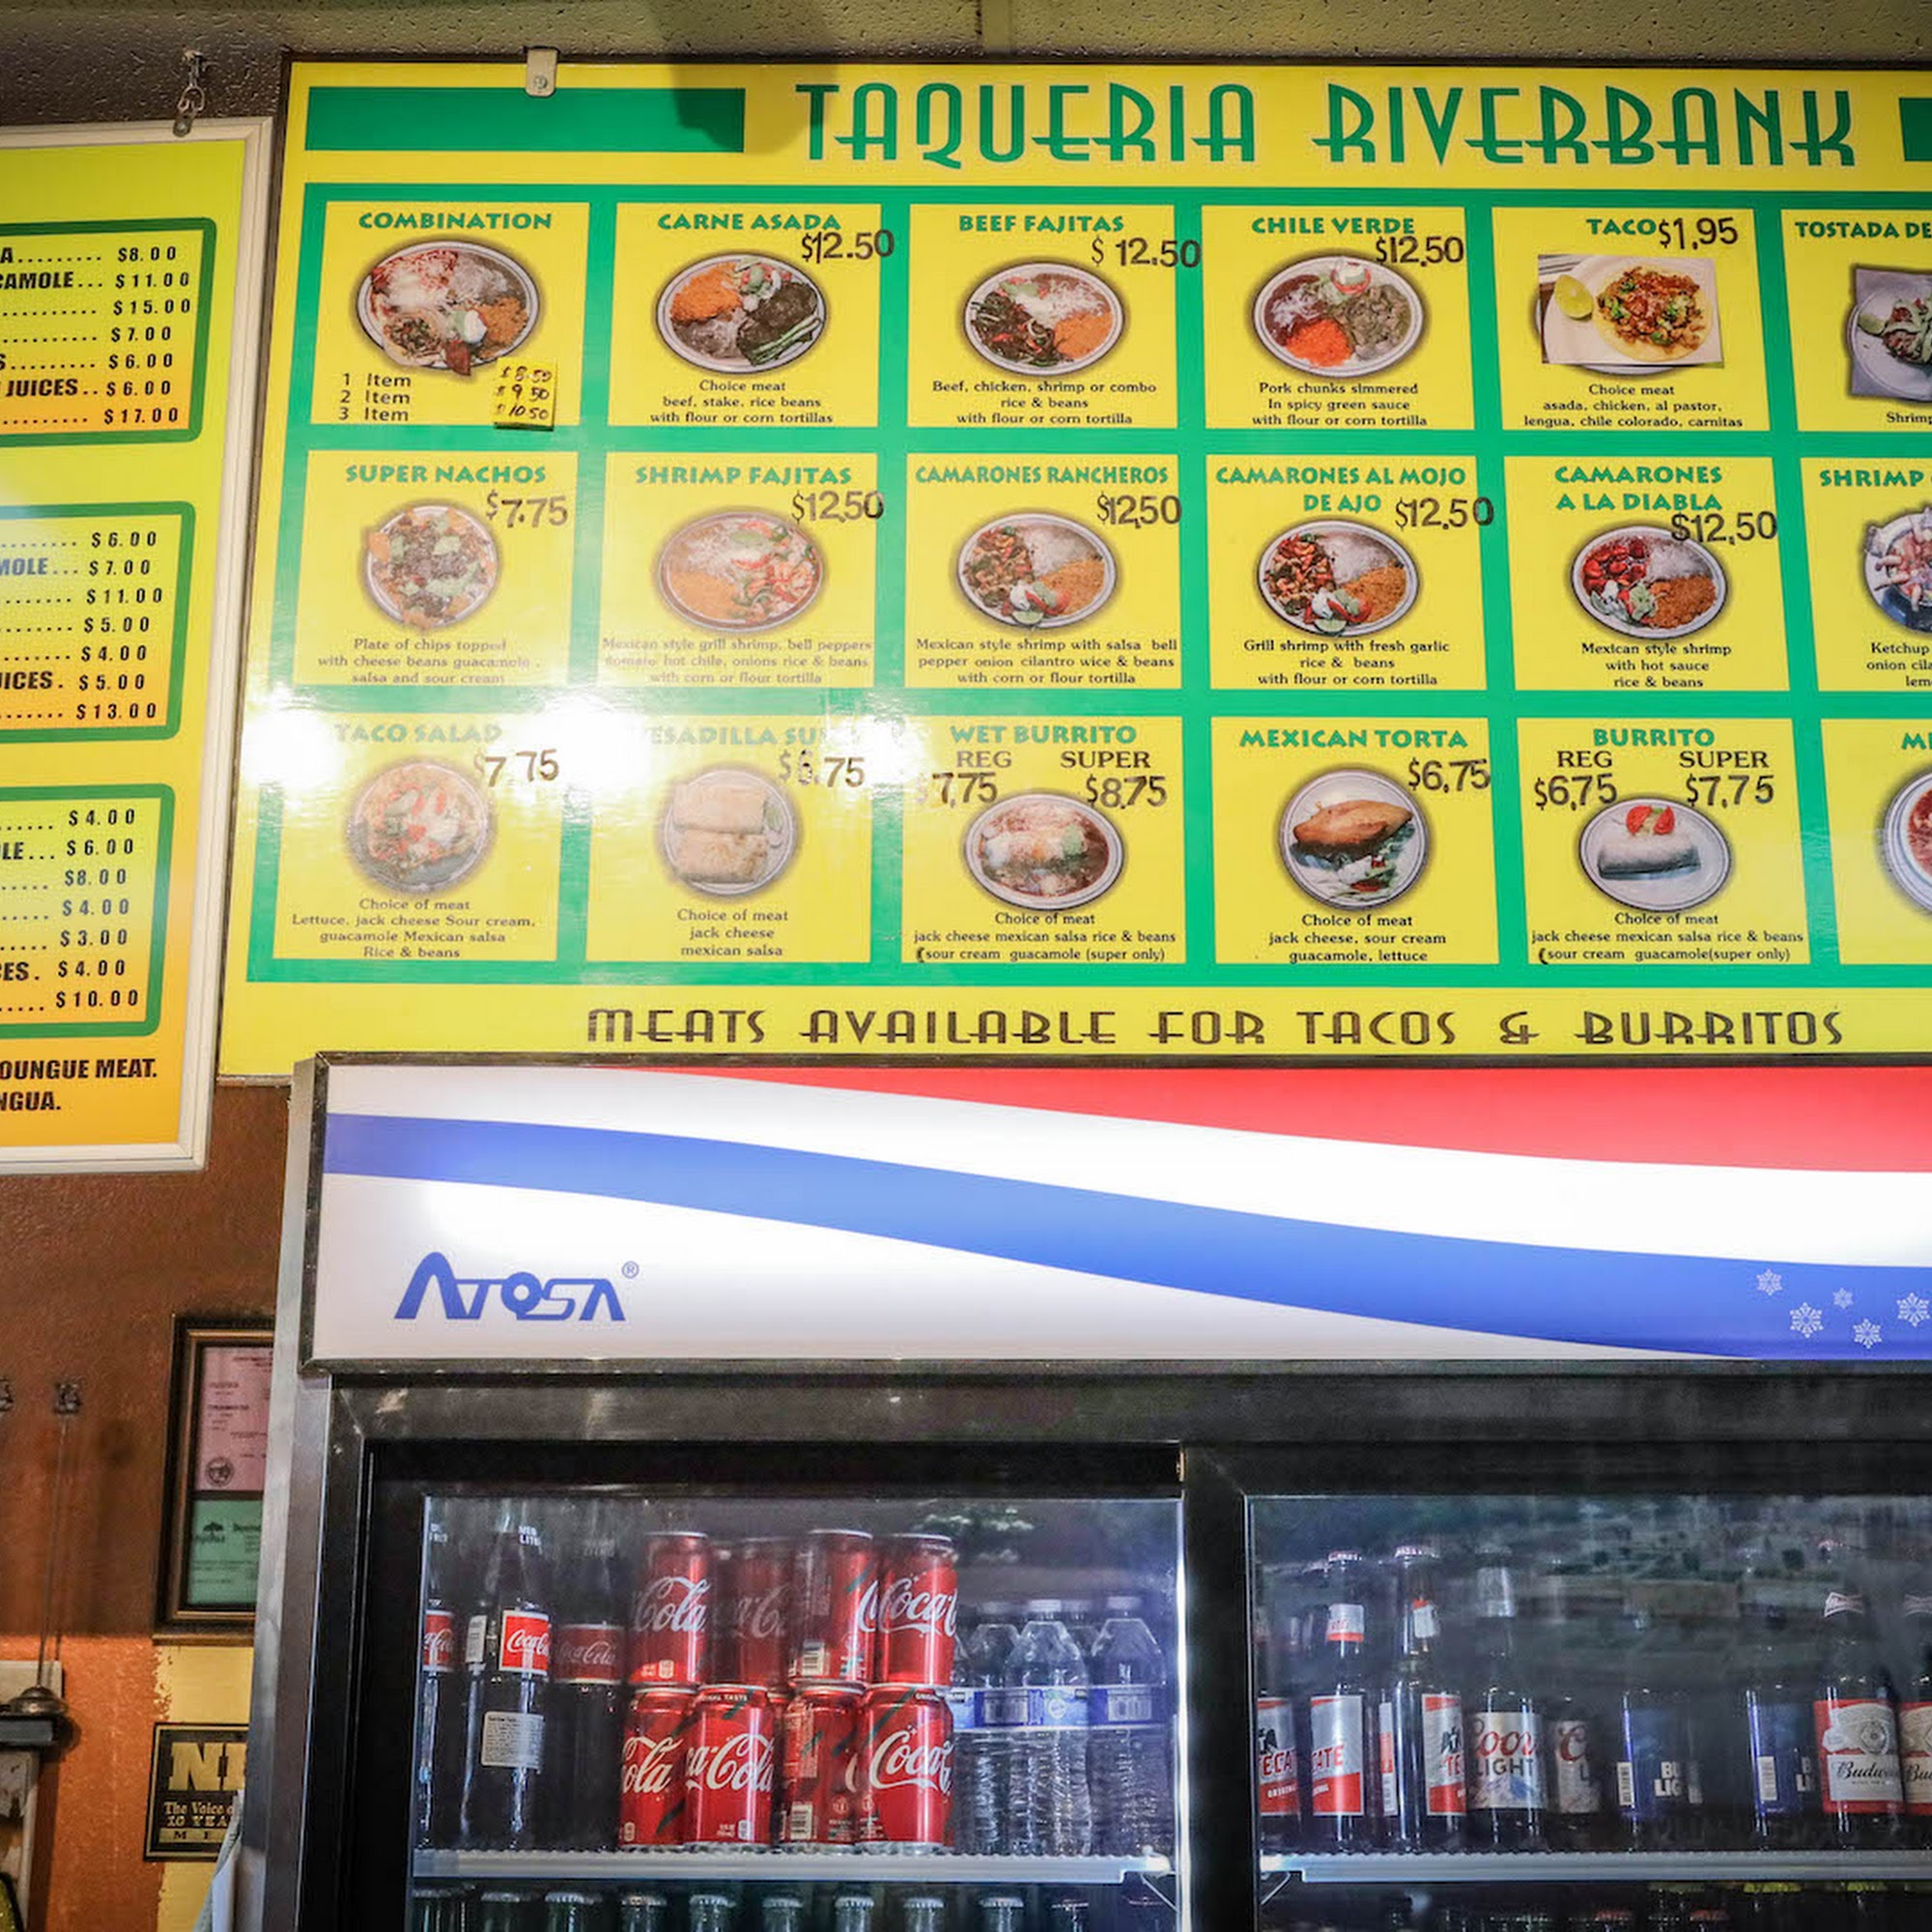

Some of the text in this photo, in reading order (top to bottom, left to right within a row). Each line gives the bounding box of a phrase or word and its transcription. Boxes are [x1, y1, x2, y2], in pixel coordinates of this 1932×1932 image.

[794, 83, 1856, 170] TAQUERIA RIVERBANK
[358, 213, 553, 228] COMBINATION
[658, 213, 841, 230] CARNE ASADA
[959, 215, 1124, 234] BEEF FAJITAS
[1252, 217, 1414, 234] CHILE VERDE
[1586, 218, 1656, 235] TACO
[1795, 221, 1932, 238] TOSTADA DE
[117, 246, 178, 263] $8.00
[802, 230, 895, 263] $12.50
[115, 272, 189, 288] $11.00
[113, 298, 191, 315] $15.00
[110, 327, 172, 343] $7.00
[108, 354, 174, 370] $6.00
[343, 373, 412, 386] 1 Item
[106, 381, 172, 397] $6.00
[340, 390, 410, 404] 2 Item
[1259, 383, 1293, 394] Pork
[1297, 383, 1346, 394] chunks
[1588, 384, 1675, 396] Choice meat
[1268, 398, 1410, 412] In spicy green sauce
[1656, 401, 1667, 412] al
[103, 408, 179, 424] $17.00
[338, 408, 410, 421] 3 Item
[1580, 416, 1611, 427] chile
[1688, 417, 1743, 427] carnitas
[346, 466, 546, 483] SUPER NACHOS
[636, 467, 852, 485] SHRIMP FAJITAS
[916, 466, 1168, 483] CAMARONES RANCHEROS
[1216, 468, 1466, 486] CAMARONES AL MOJO
[1555, 466, 1722, 483] CAMARONES
[1820, 469, 1923, 487] SHRIMP
[487, 489, 568, 527] $7.75
[1304, 495, 1381, 513] DE AJO
[1556, 495, 1722, 510] A LA DIABLA
[1395, 497, 1493, 529] $12.50
[92, 531, 156, 548] $6.00
[89, 560, 151, 576] $7.00
[86, 587, 162, 604] $11.00
[83, 616, 150, 633] $5.00
[81, 645, 147, 662] $4.00
[1244, 639, 1449, 654] Grill shrimp with fresh garlic
[1581, 643, 1731, 657] Mexican style shrimp
[1871, 642, 1930, 656] Ketchup
[1300, 657, 1395, 668] rice & beans
[1605, 660, 1710, 670] with hot sauce
[1866, 661, 1906, 670] onion
[78, 674, 146, 691] $5.00
[1258, 674, 1289, 684] with
[1293, 674, 1326, 684] flour
[1352, 676, 1384, 685] corn
[1390, 674, 1437, 685] tortilla
[1614, 676, 1704, 688] rice & beans
[76, 702, 156, 720] $13.00
[951, 726, 1136, 744] WET BURRITO
[1239, 730, 1468, 748] MEXICAN TORTA
[1594, 728, 1715, 746] BURRITO
[956, 751, 1151, 769] REG SUPER
[1557, 751, 1770, 769] REG SUPER
[1086, 774, 1167, 809] $8.75
[68, 809, 135, 827] $4.00
[67, 838, 133, 857] $6.00
[65, 868, 127, 886] $8.00
[62, 899, 129, 917] $4.00
[1302, 915, 1412, 926] Choice of meat
[60, 929, 128, 947] $3.00
[690, 927, 775, 941] jack cheese
[1269, 933, 1298, 945] jack
[1364, 935, 1396, 945] sour
[1402, 935, 1447, 945] cream
[680, 944, 782, 956] mexican salsa
[1379, 951, 1428, 962] lettuce
[58, 959, 126, 978] $4.00
[55, 990, 139, 1008] $10.00
[586, 1009, 1845, 1047] MEATS AVAILABLE FOR TACOS & BURRITOS
[95, 1058, 157, 1078] MEAT.
[633, 1577, 711, 1633] Cola
